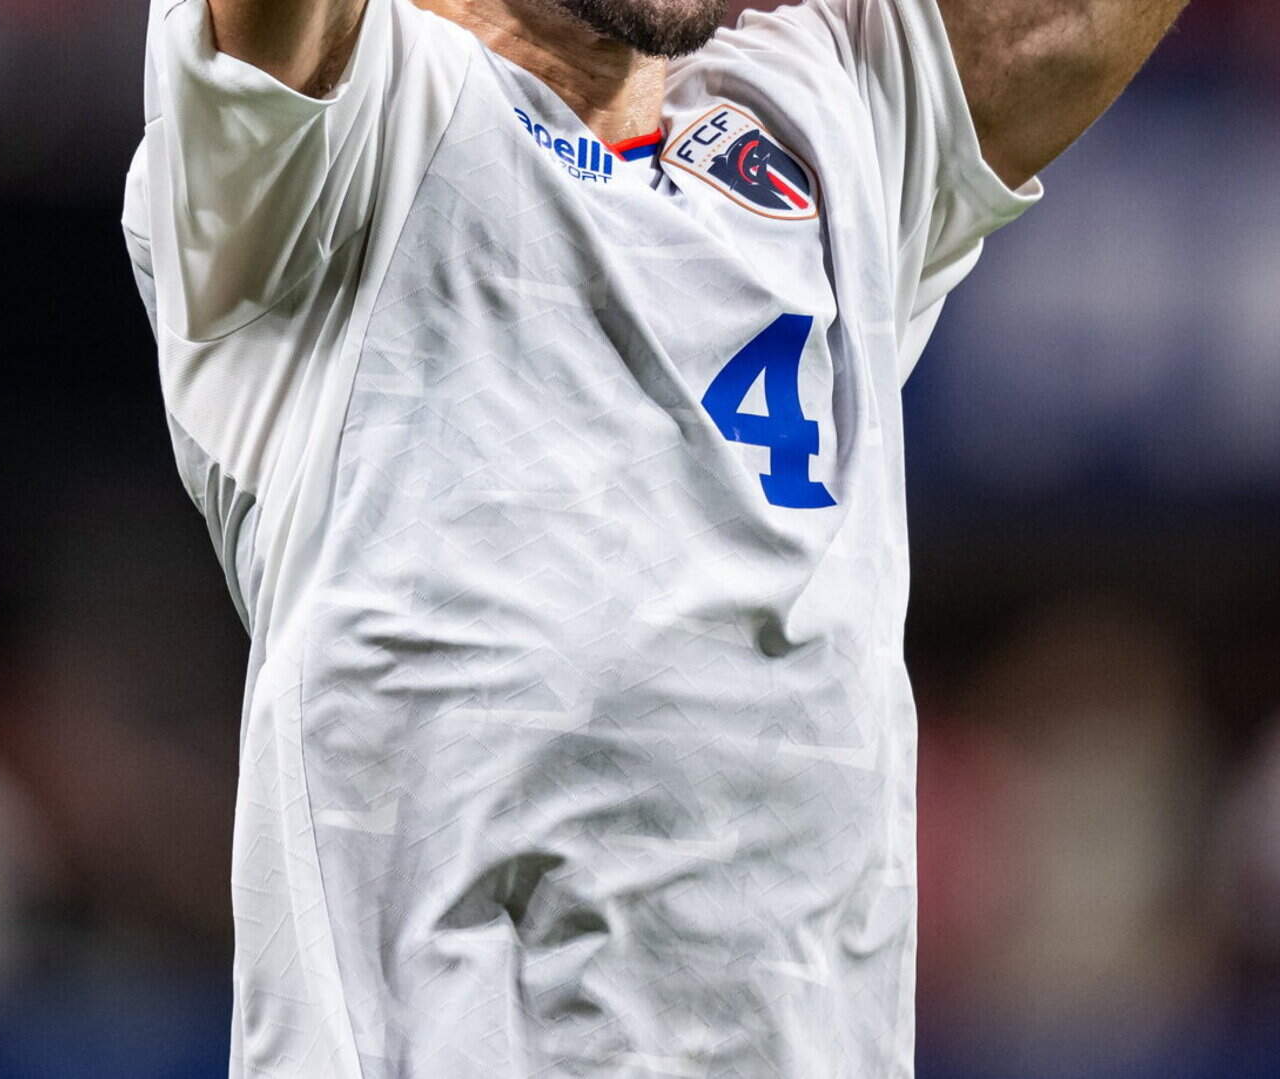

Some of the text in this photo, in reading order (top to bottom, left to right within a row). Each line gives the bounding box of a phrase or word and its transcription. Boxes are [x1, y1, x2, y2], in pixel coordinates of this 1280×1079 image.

[514, 107, 613, 175] apelli
[676, 111, 729, 164] FCF
[560, 161, 612, 183] ORT
[700, 312, 838, 510] 4
